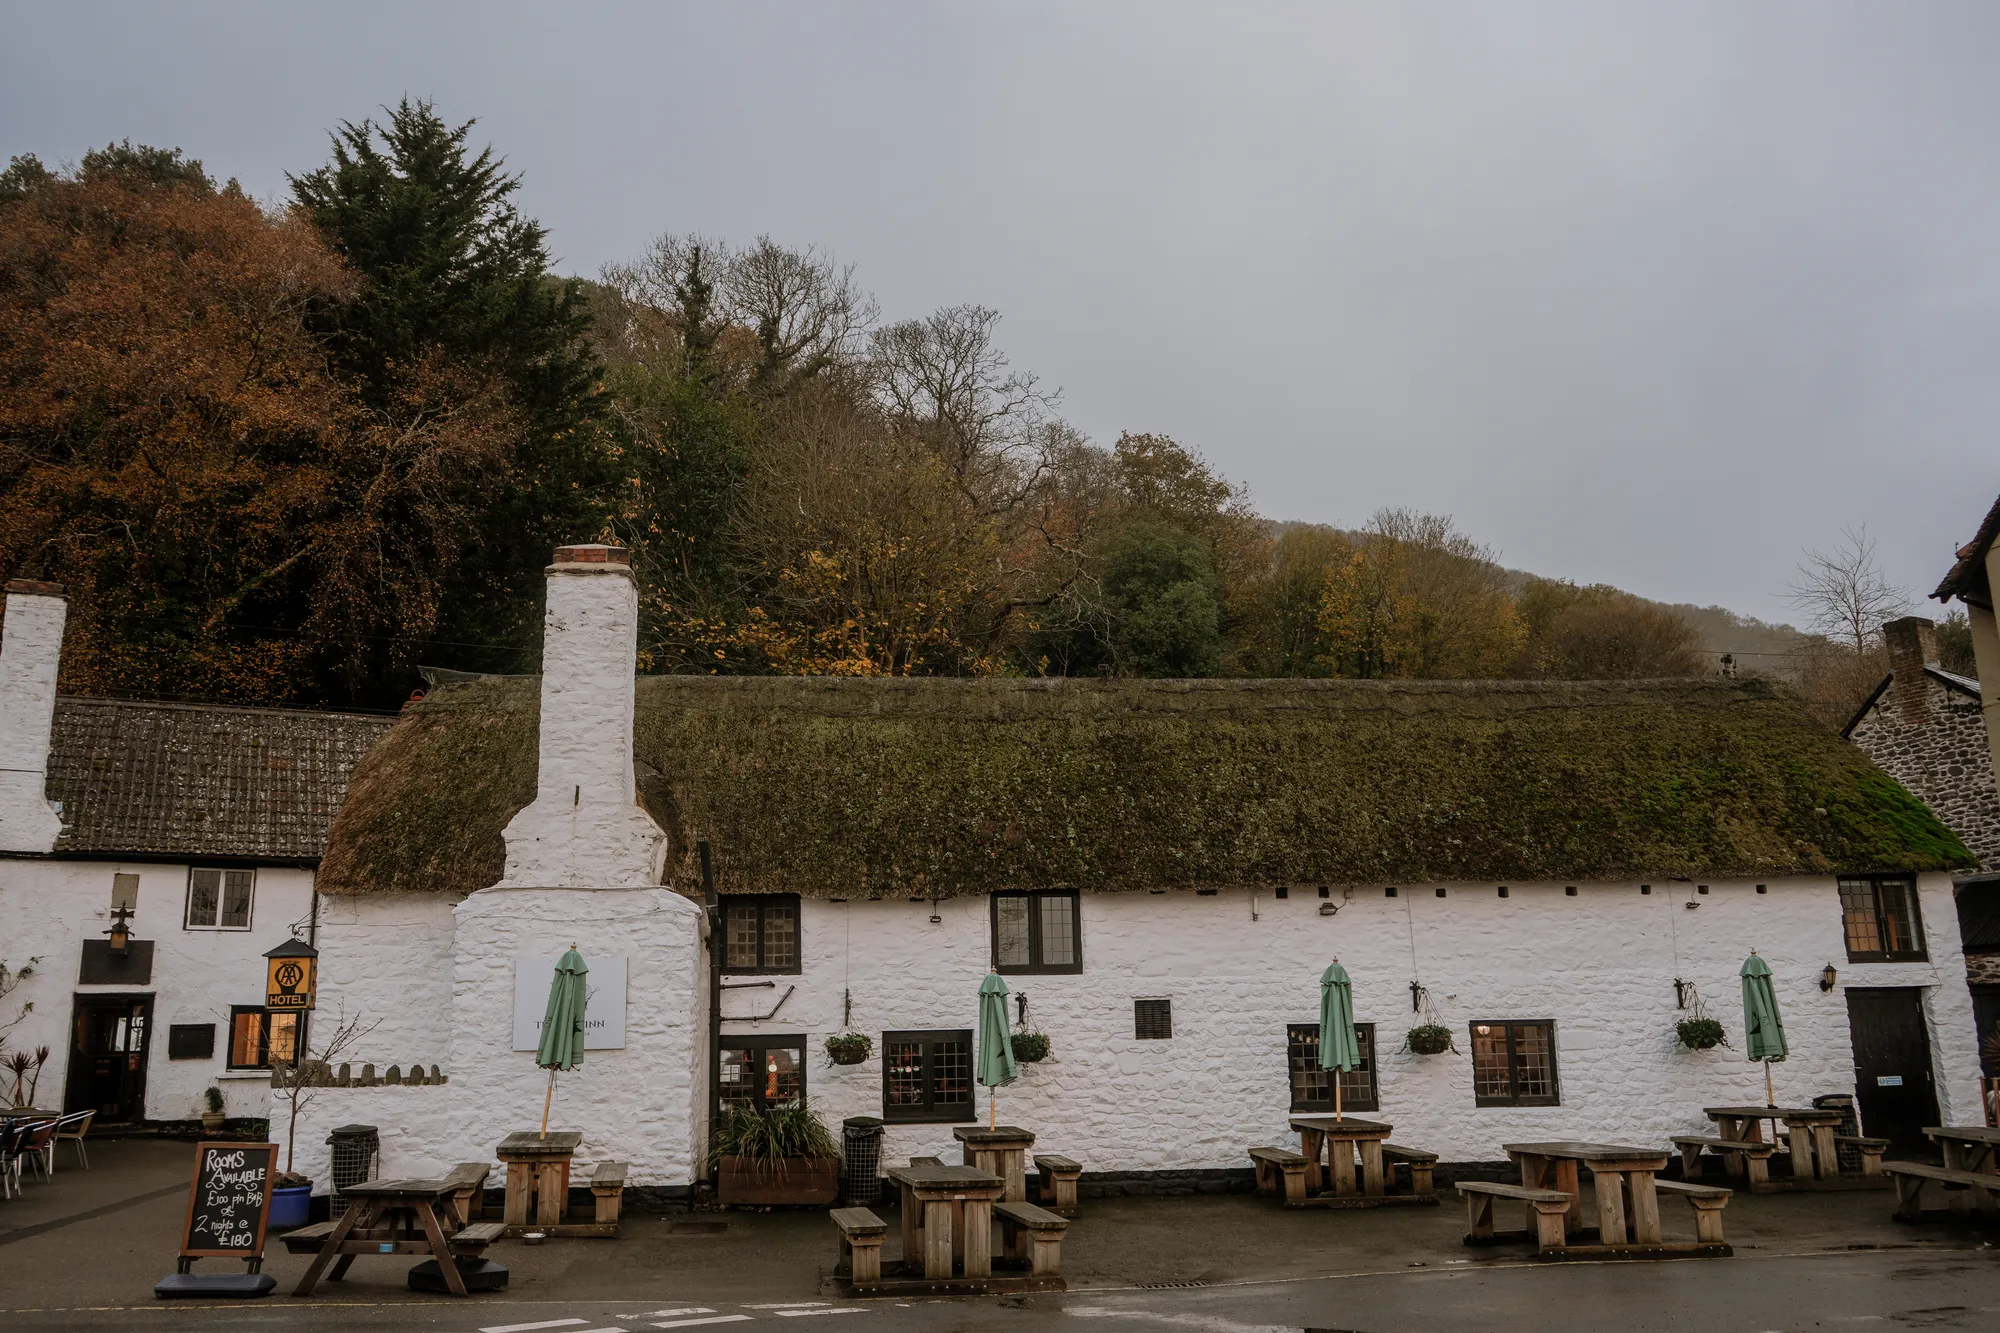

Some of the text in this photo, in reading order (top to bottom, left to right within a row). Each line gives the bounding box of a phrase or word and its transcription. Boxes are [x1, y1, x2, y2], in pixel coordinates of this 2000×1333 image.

[270, 995, 304, 1005] HOTEL
[585, 1020, 605, 1028] INN
[206, 1149, 245, 1172] ROOMS
[210, 1167, 266, 1184] AVAILABLE
[206, 1190, 229, 1207] £100
[195, 1214, 249, 1236] 2 nights @
[218, 1230, 253, 1247] £180
